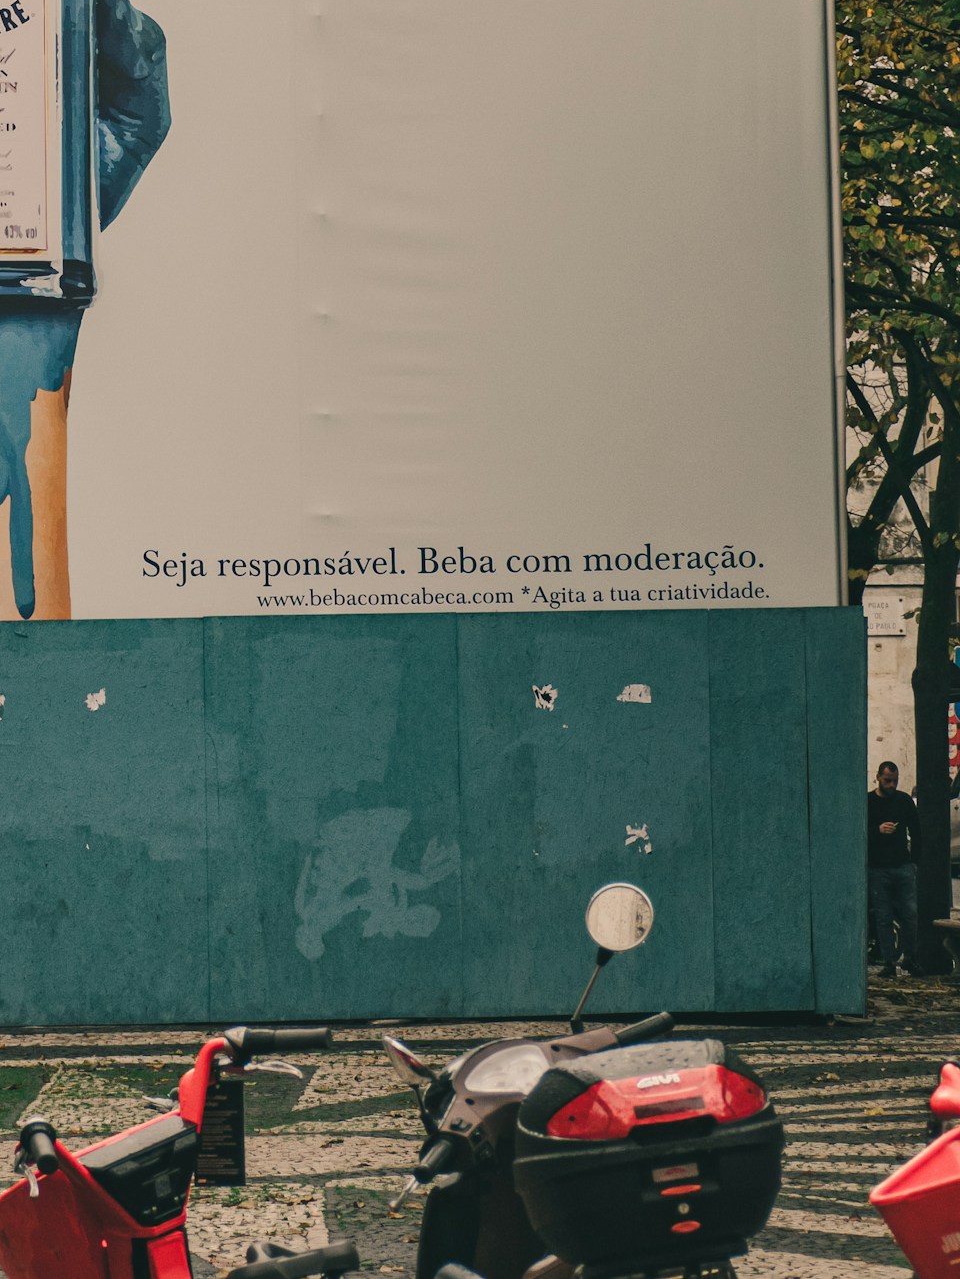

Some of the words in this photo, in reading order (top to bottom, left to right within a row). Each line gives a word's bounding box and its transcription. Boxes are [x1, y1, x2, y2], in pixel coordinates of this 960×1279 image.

[142, 549, 207, 587] Seja
[217, 546, 406, 587] responsável.
[417, 545, 496, 575] Beba
[506, 553, 573, 574] com
[583, 543, 765, 577] moderação.
[256, 586, 514, 608] www.bebacomcabeca.com
[593, 590, 604, 602] a
[610, 586, 641, 602] tua
[647, 581, 770, 601] criatividade.
